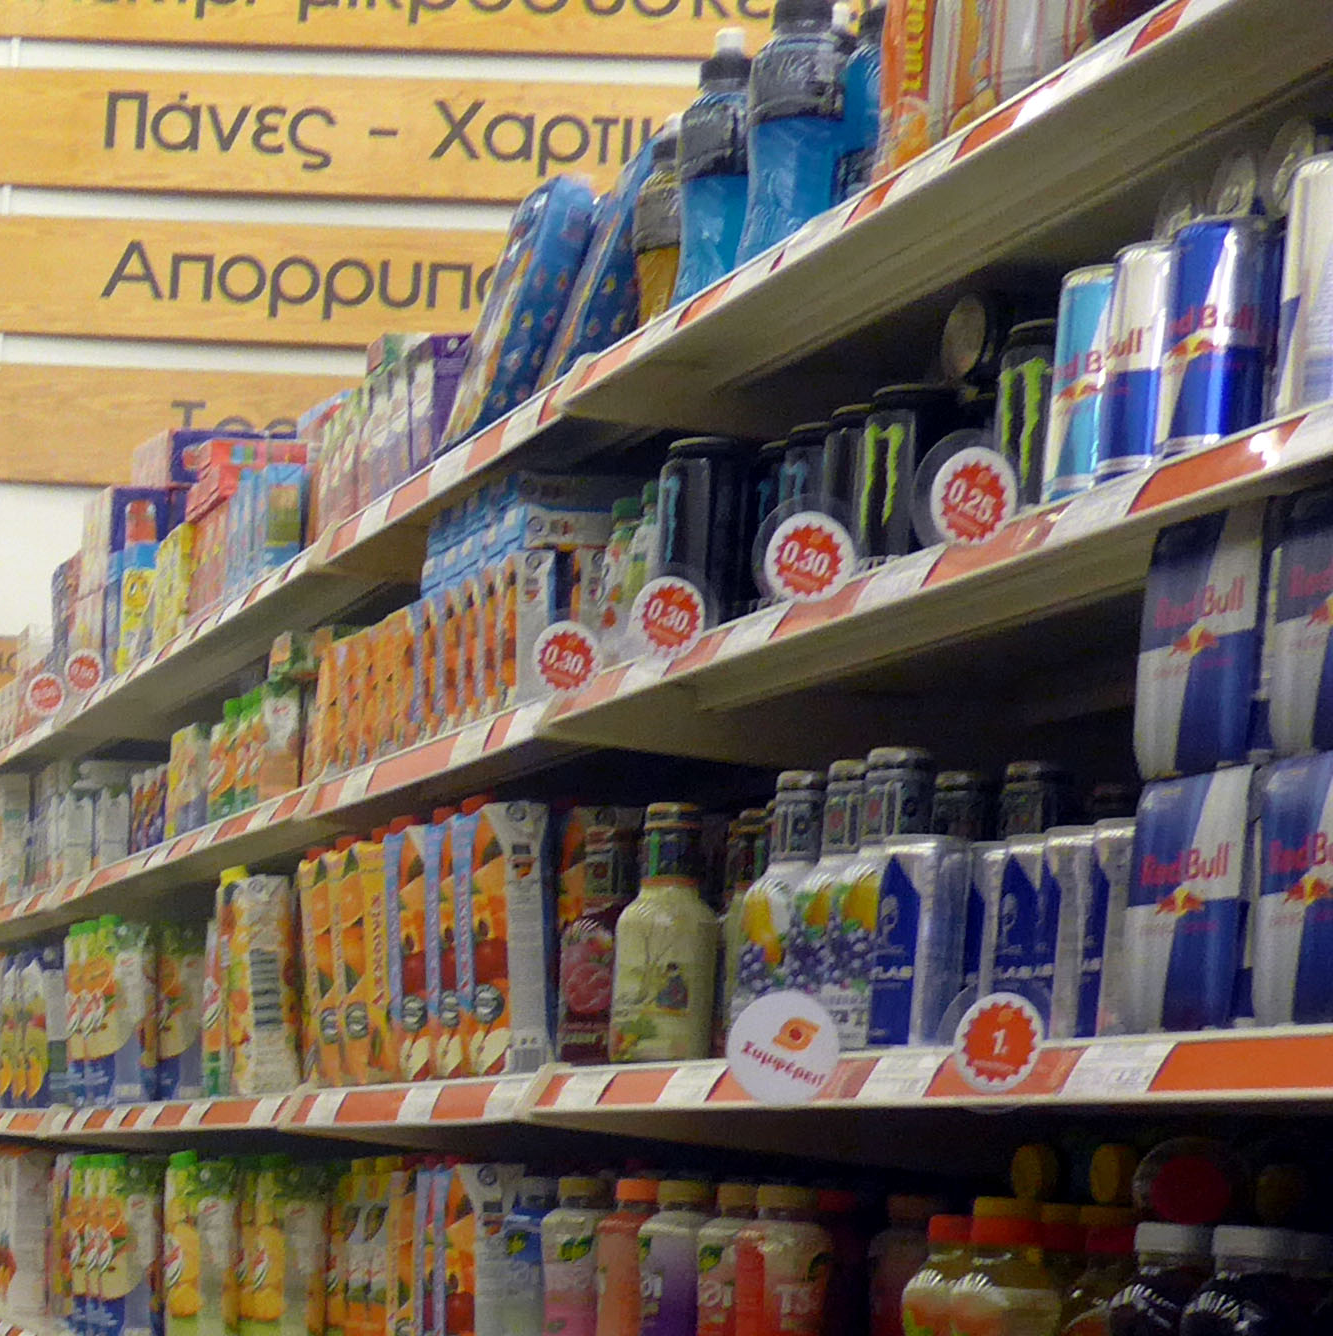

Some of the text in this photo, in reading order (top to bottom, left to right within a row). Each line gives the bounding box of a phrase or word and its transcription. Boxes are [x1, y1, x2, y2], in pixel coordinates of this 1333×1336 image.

[103, 91, 336, 170] Πάνες
[1154, 576, 1246, 630] Red Bull
[1140, 841, 1231, 888] Red Bull
[1269, 834, 1310, 875] Red
